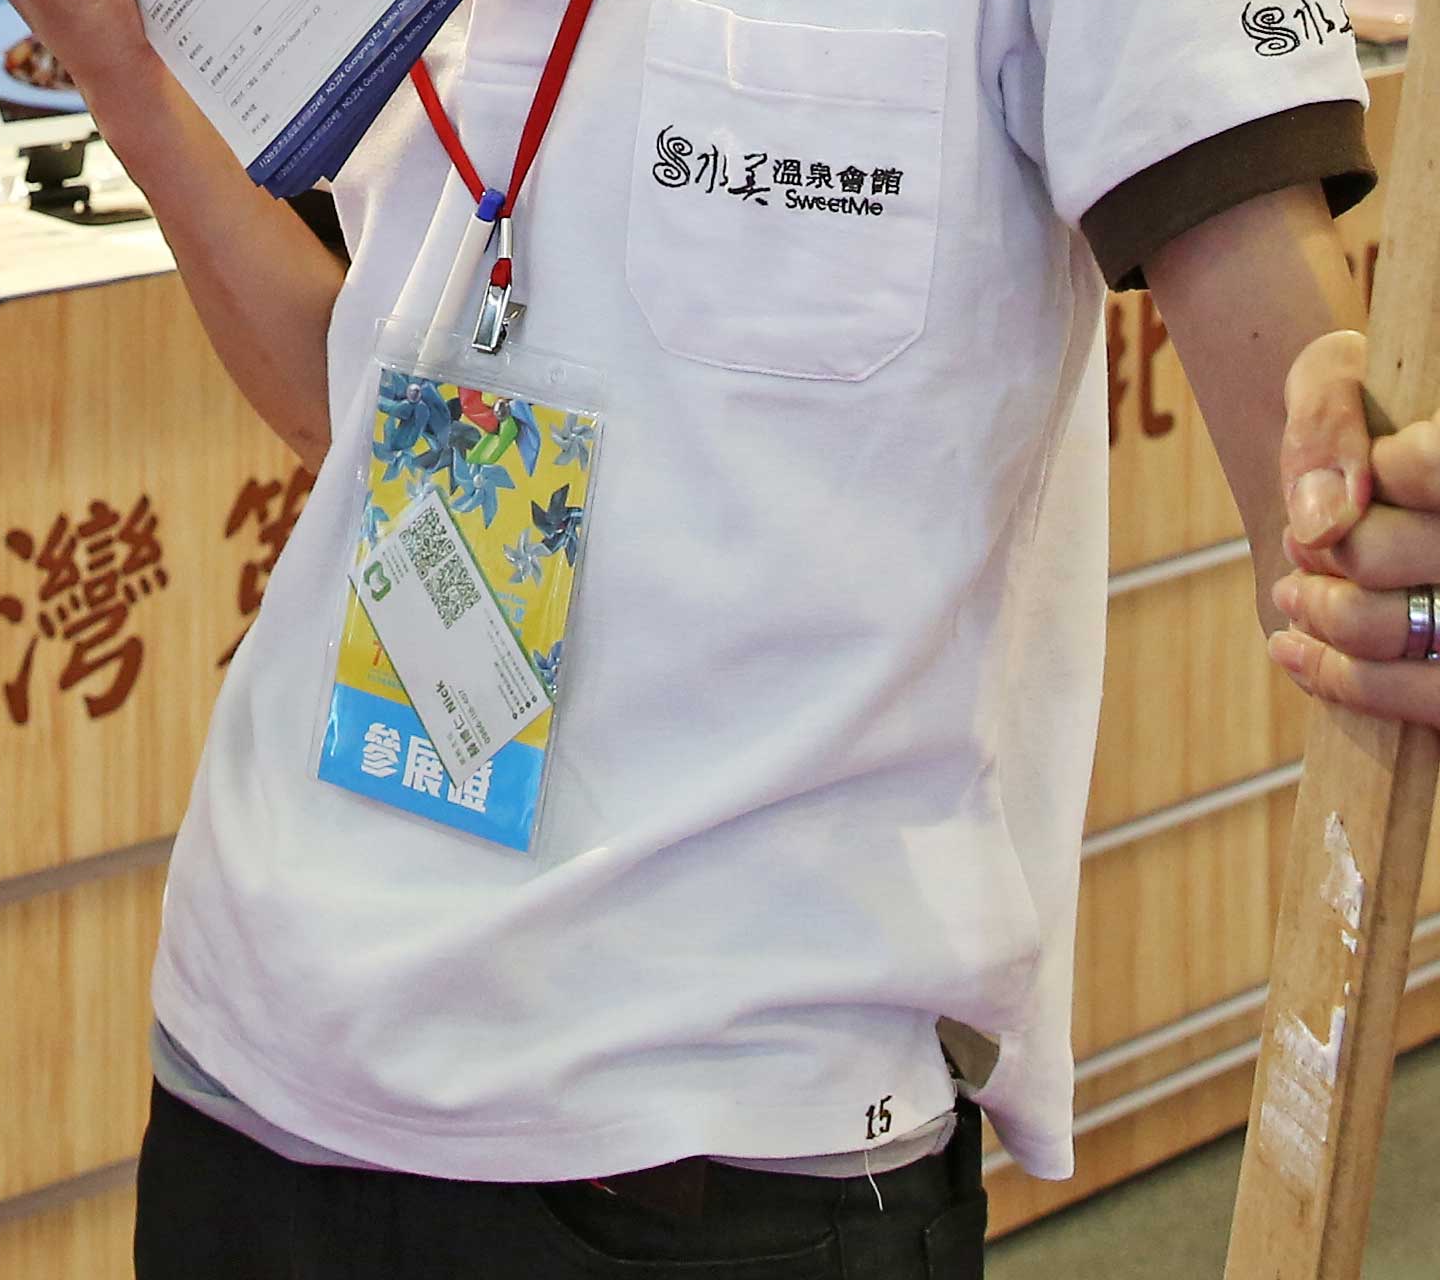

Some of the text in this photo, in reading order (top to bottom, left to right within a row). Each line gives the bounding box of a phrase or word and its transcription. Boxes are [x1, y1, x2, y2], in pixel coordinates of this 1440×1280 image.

[773, 158, 904, 196] 溫泉會館
[785, 189, 884, 216] SweetMe
[434, 679, 457, 717] Nick
